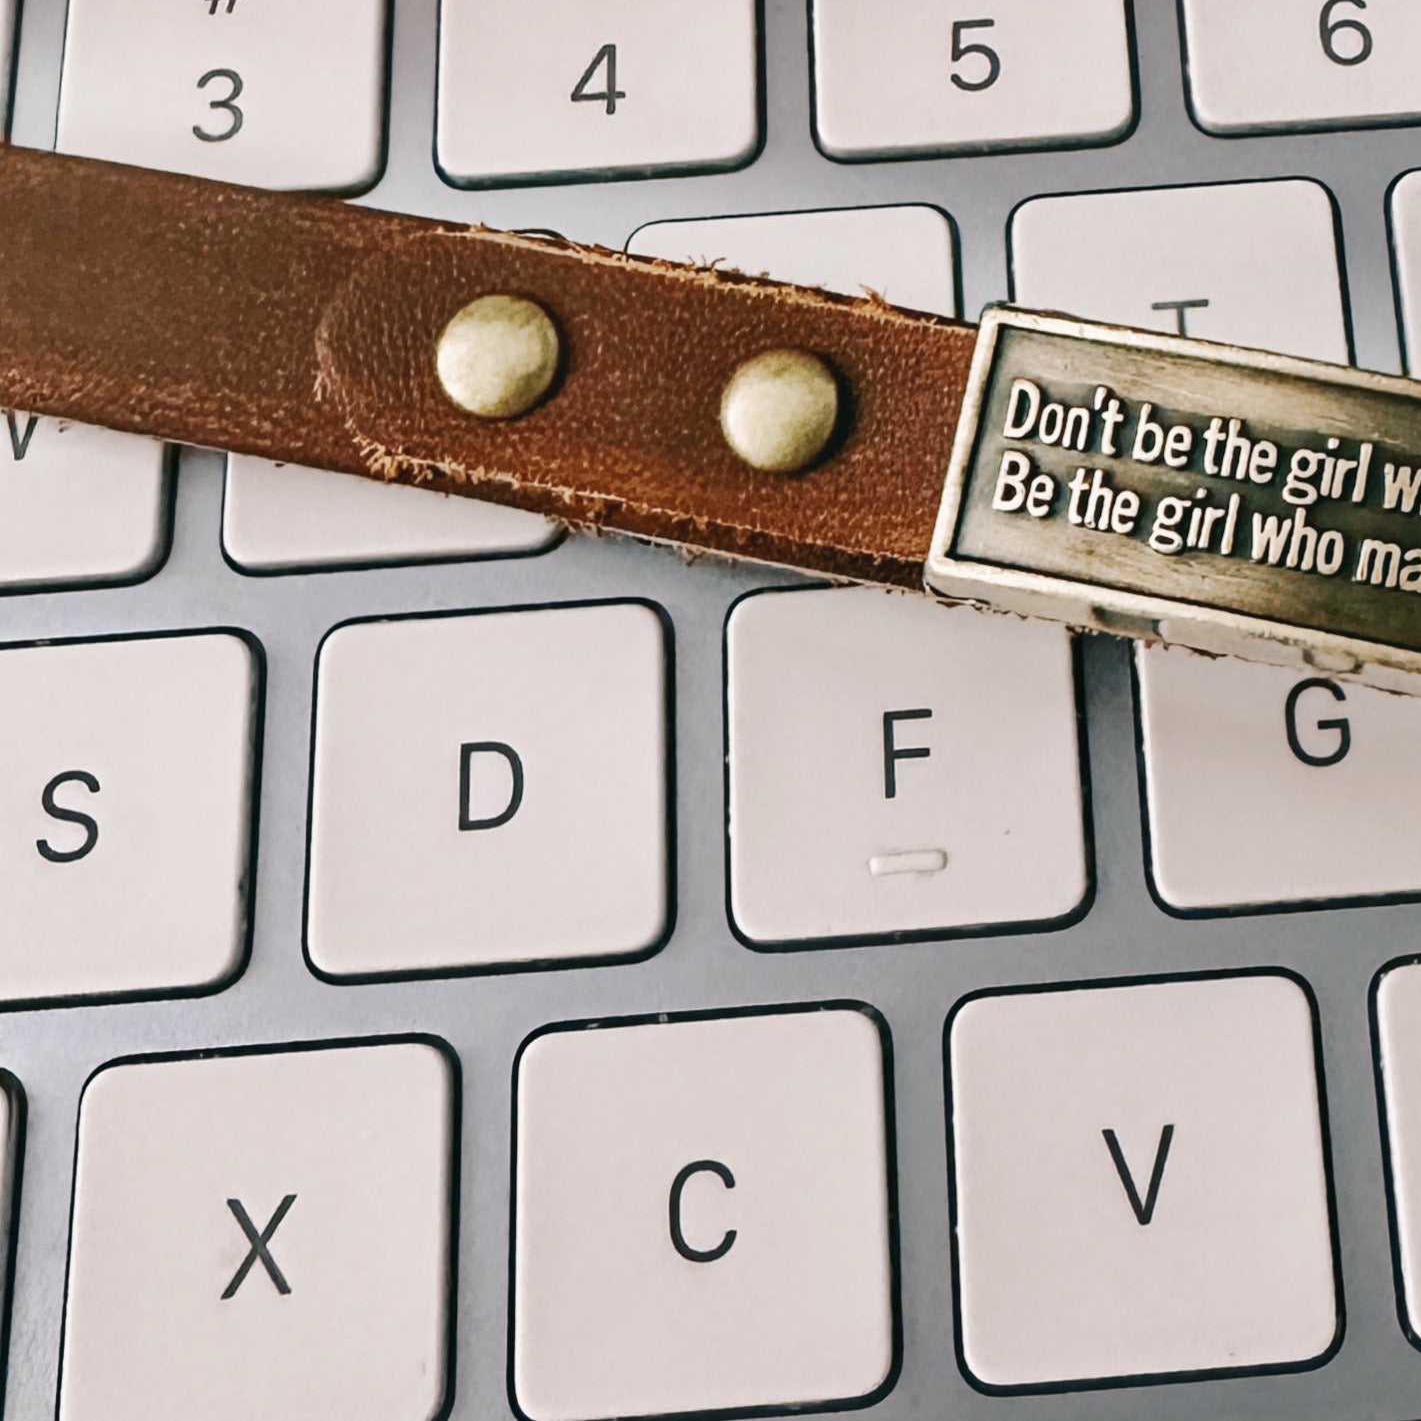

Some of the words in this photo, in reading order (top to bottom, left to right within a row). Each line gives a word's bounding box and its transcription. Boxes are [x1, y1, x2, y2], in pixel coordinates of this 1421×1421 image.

[569, 43, 627, 116] 4
[950, 18, 1001, 93] 5
[191, 67, 244, 144] 3
[1002, 378, 1125, 456] Don't
[1131, 402, 1193, 469] be
[1202, 416, 1278, 484] the
[1281, 436, 1374, 506] girl
[991, 449, 1055, 519] Be
[1067, 466, 1141, 535] the
[1147, 487, 1241, 555] girl
[1251, 506, 1344, 576] who
[882, 707, 933, 800] F
[1284, 677, 1351, 767] G
[35, 769, 101, 864] S
[457, 740, 525, 832] D
[668, 1159, 738, 1264] C
[1101, 1123, 1175, 1227] V
[219, 1193, 298, 1301] X
